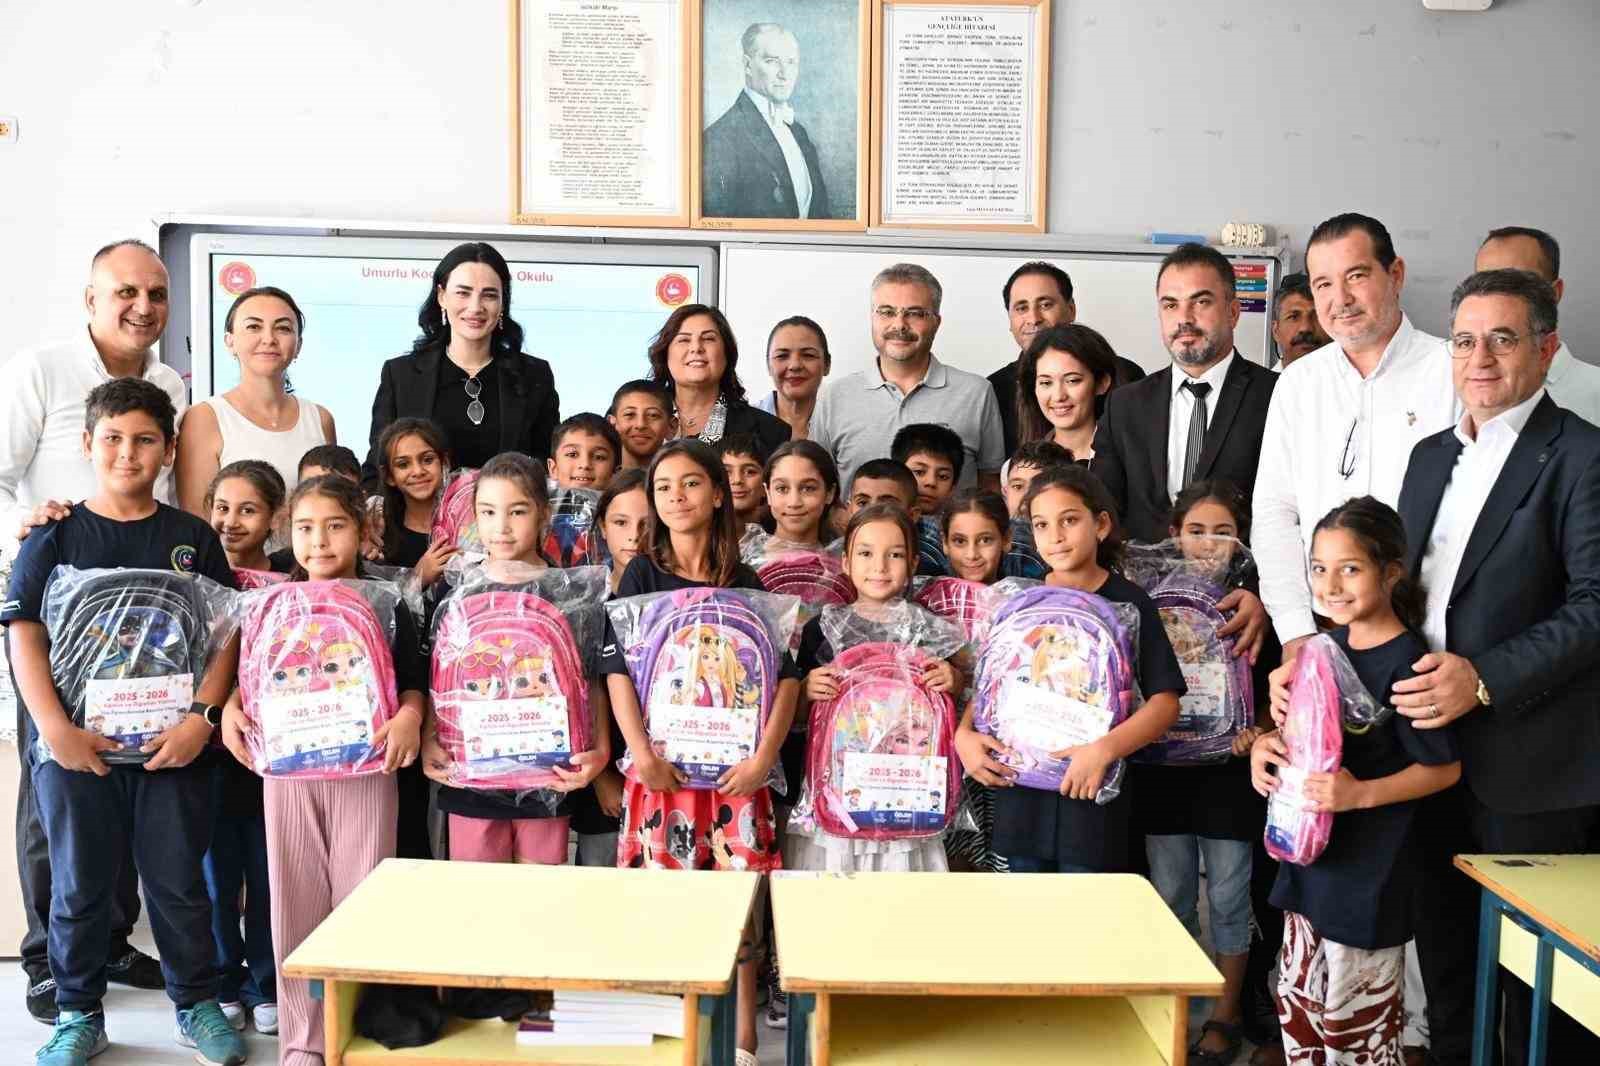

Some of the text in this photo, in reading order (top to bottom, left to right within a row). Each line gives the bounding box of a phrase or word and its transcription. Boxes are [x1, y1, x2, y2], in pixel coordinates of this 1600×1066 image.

[362, 265, 408, 280] Umurlu
[517, 271, 554, 282] Okulu
[113, 692, 137, 701] 2025
[146, 689, 169, 699] 2026
[487, 713, 510, 722] 2025
[518, 711, 542, 721] 2026
